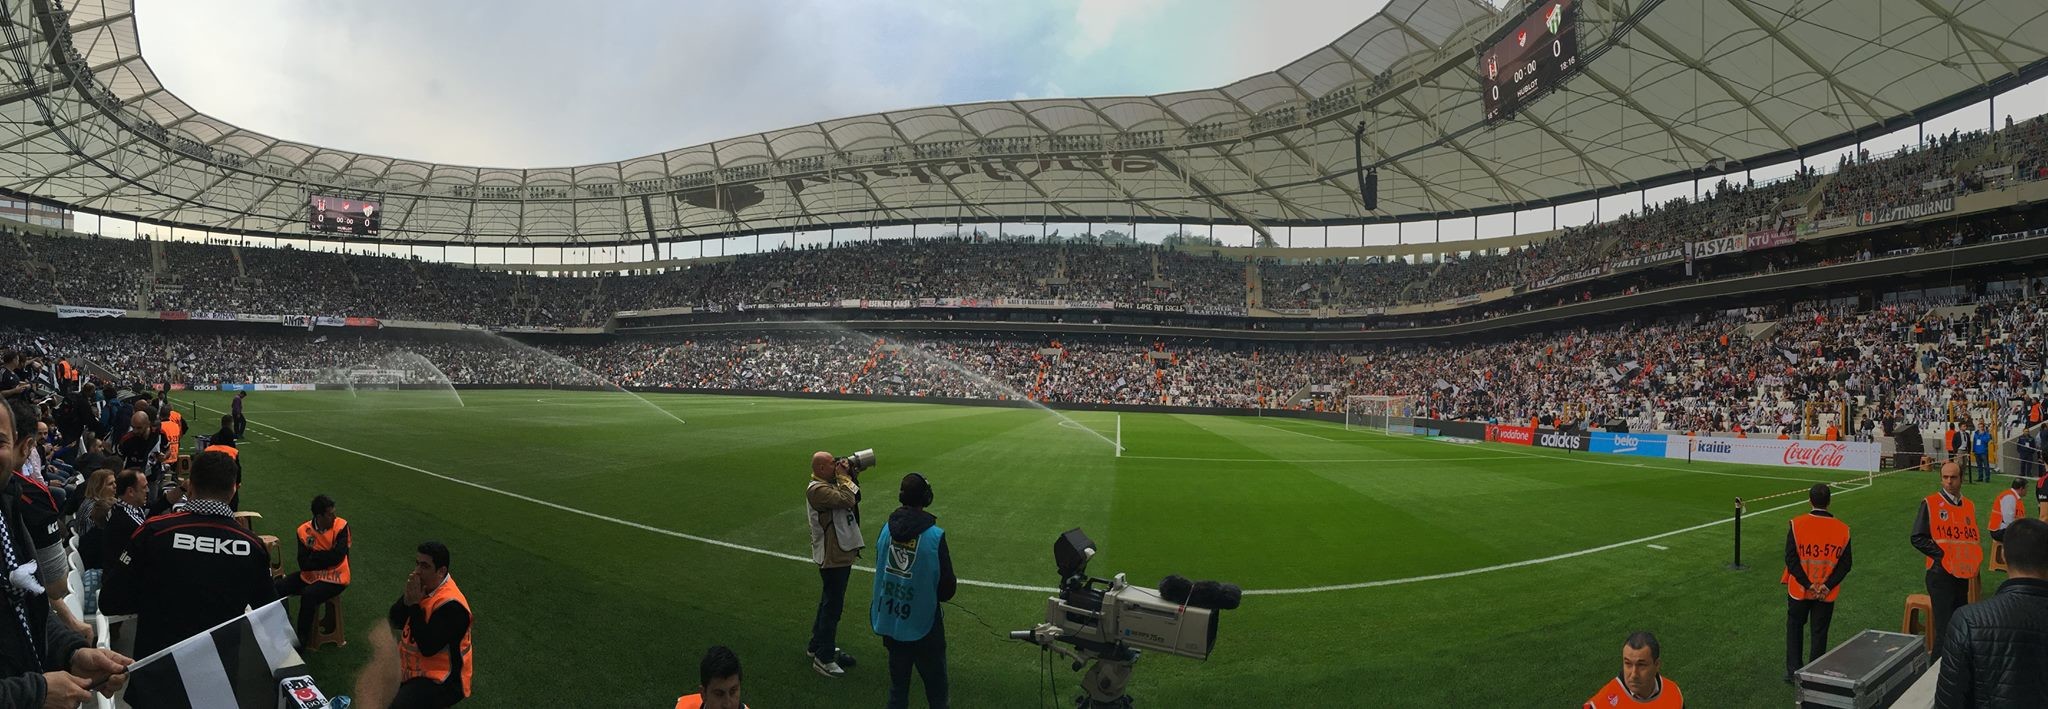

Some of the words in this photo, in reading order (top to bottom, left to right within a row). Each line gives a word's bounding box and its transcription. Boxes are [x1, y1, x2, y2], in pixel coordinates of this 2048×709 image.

[1553, 39, 1561, 57] 0
[1514, 60, 1537, 83] 00:00
[1492, 85, 1499, 100] 0
[1517, 79, 1538, 97] HUBLOT
[318, 214, 324, 222] 0
[364, 219, 370, 227] 0
[1696, 238, 1735, 257] ASYA
[1748, 232, 1769, 247] KTÜ
[1500, 428, 1529, 441] vodafone
[1541, 431, 1580, 449] adidas
[1614, 434, 1639, 447] beko
[173, 533, 251, 556] BEKO
